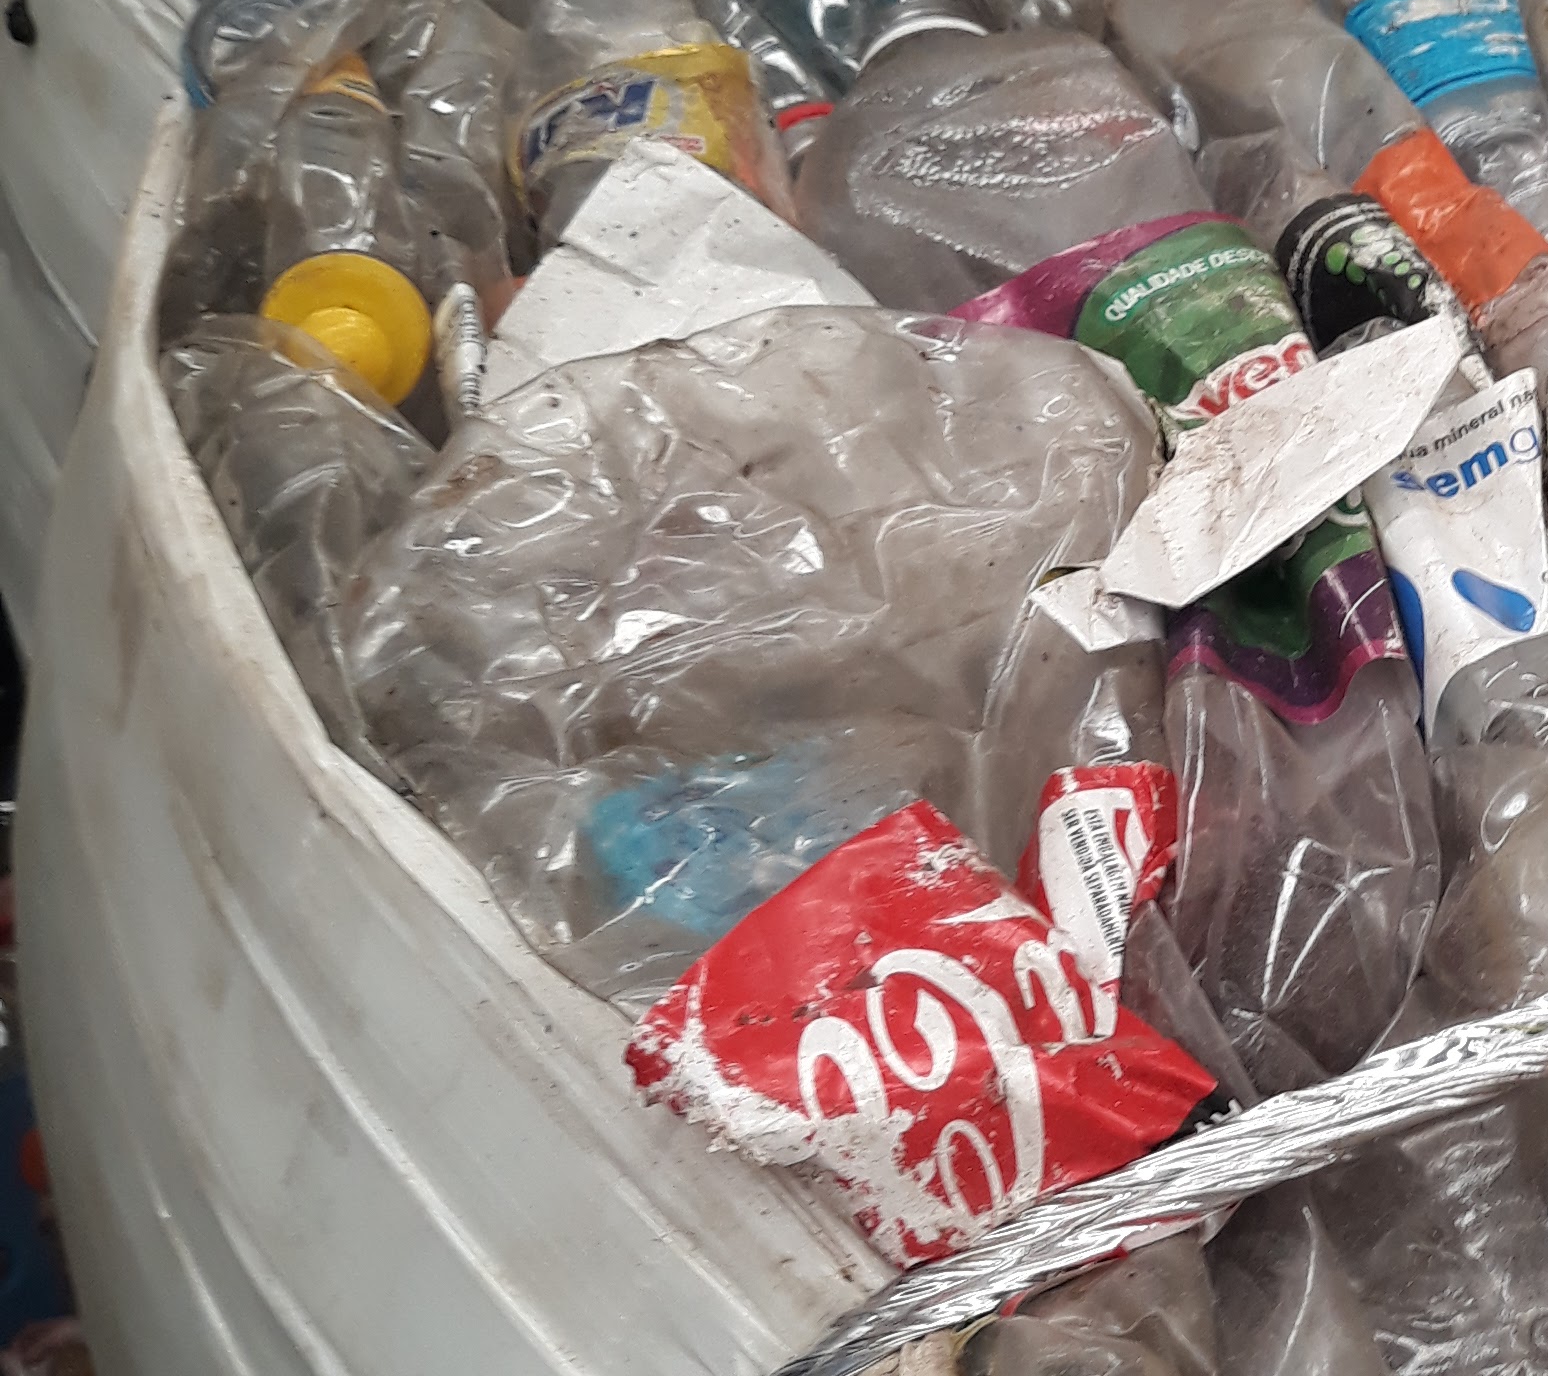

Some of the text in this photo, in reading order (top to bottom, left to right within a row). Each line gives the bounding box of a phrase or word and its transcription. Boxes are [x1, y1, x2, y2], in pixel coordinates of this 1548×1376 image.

[1104, 257, 1209, 322] QUALIDADE
[1433, 398, 1505, 450] mineral
[1082, 808, 1107, 832] ESTA
[1061, 807, 1126, 958] SER VENDIDA SEPARADAMENTE
[1092, 829, 1130, 894] EMBALAGEM
